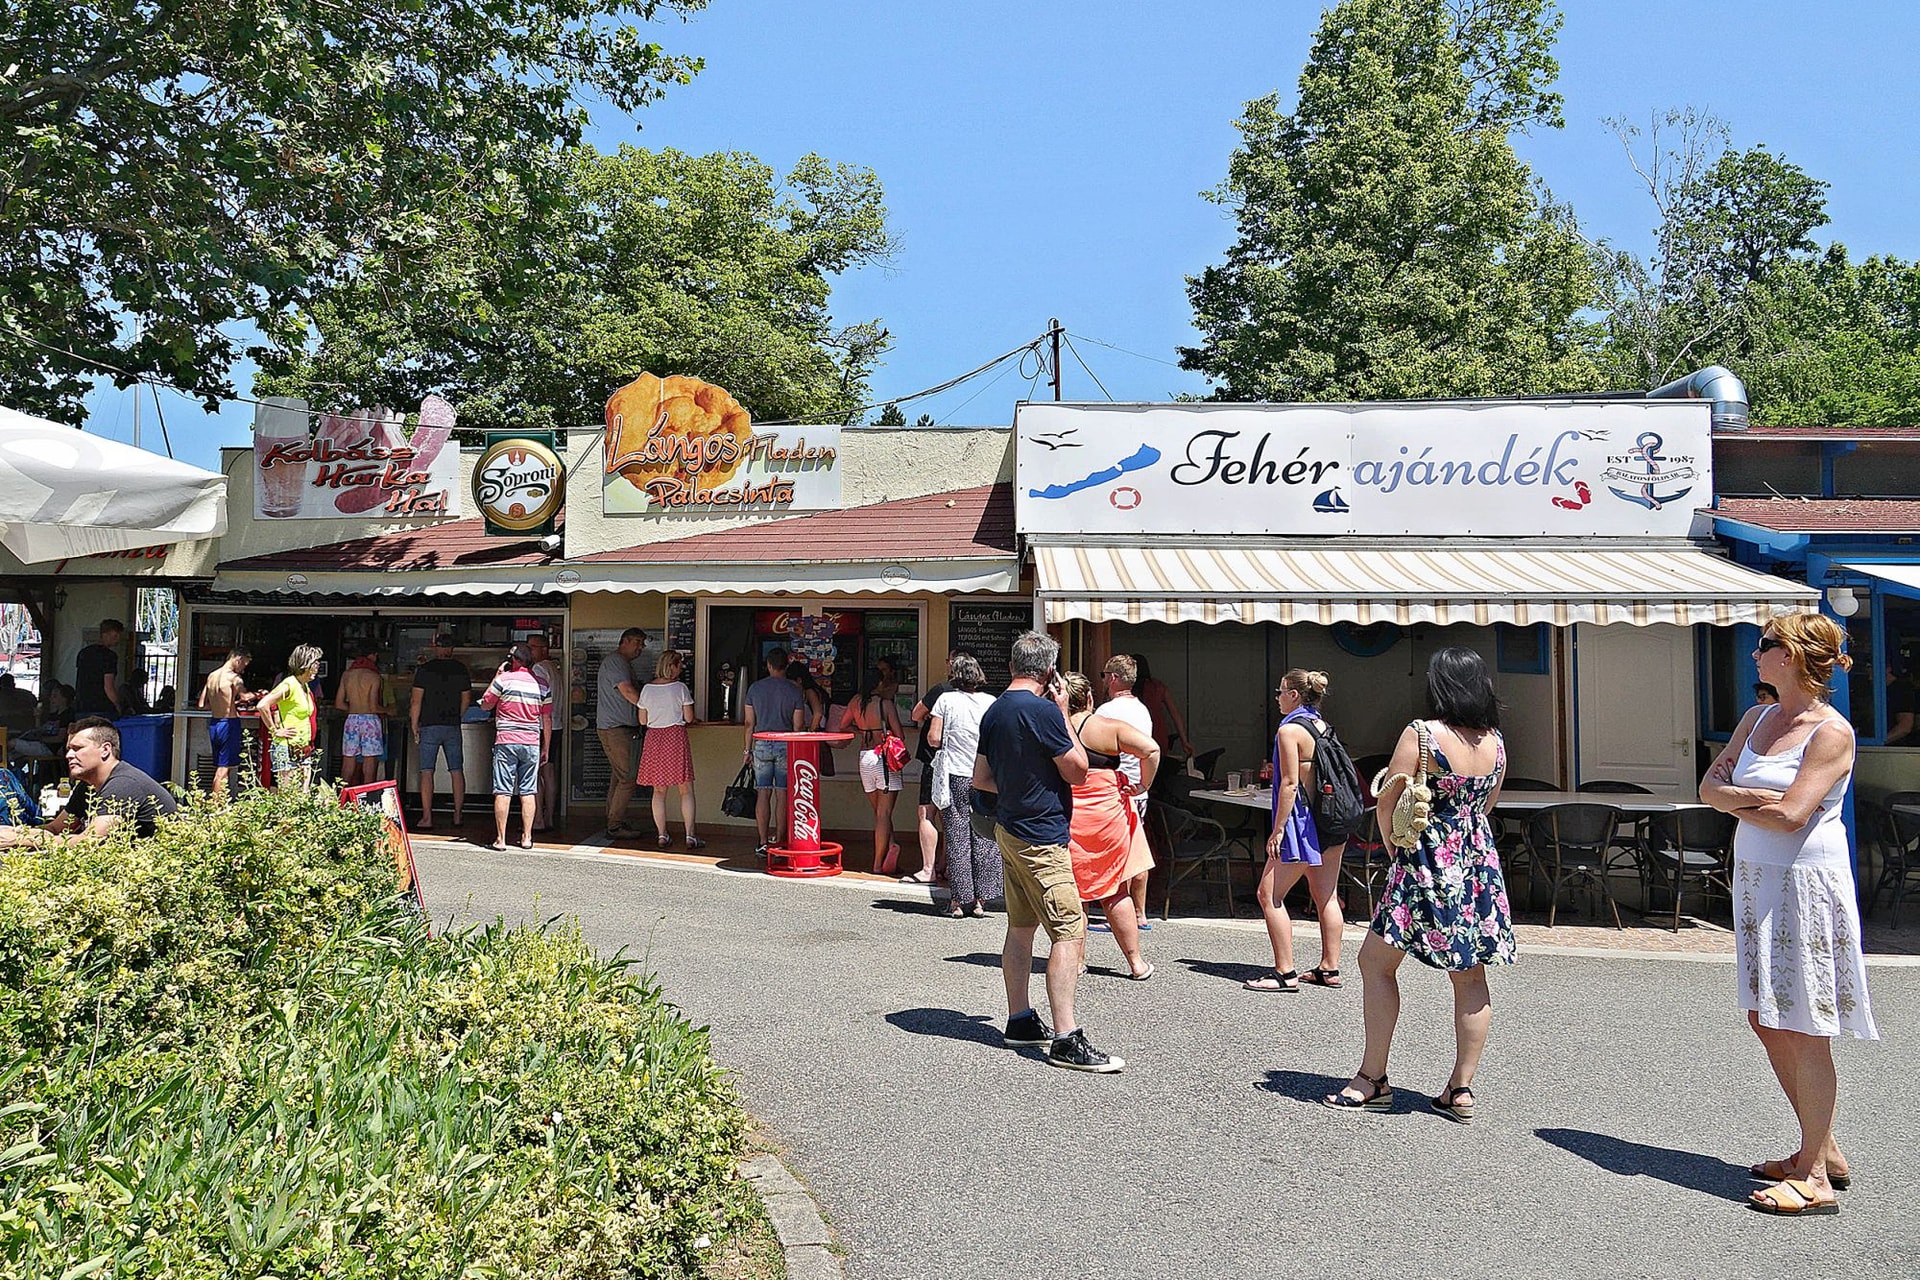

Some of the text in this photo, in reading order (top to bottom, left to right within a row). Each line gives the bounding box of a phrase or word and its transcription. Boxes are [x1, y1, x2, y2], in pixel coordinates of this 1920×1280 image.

[261, 437, 417, 468] Kolbász
[606, 411, 837, 473] Lángos Fladen
[1170, 429, 1579, 492] Fehér ajándék
[1607, 456, 1695, 464] EST 1987
[312, 464, 432, 489] Hurka
[478, 463, 557, 504] Soproni
[645, 477, 796, 507] Palacsinta
[385, 489, 449, 513] Hal
[793, 759, 819, 845] Coca-Cola
